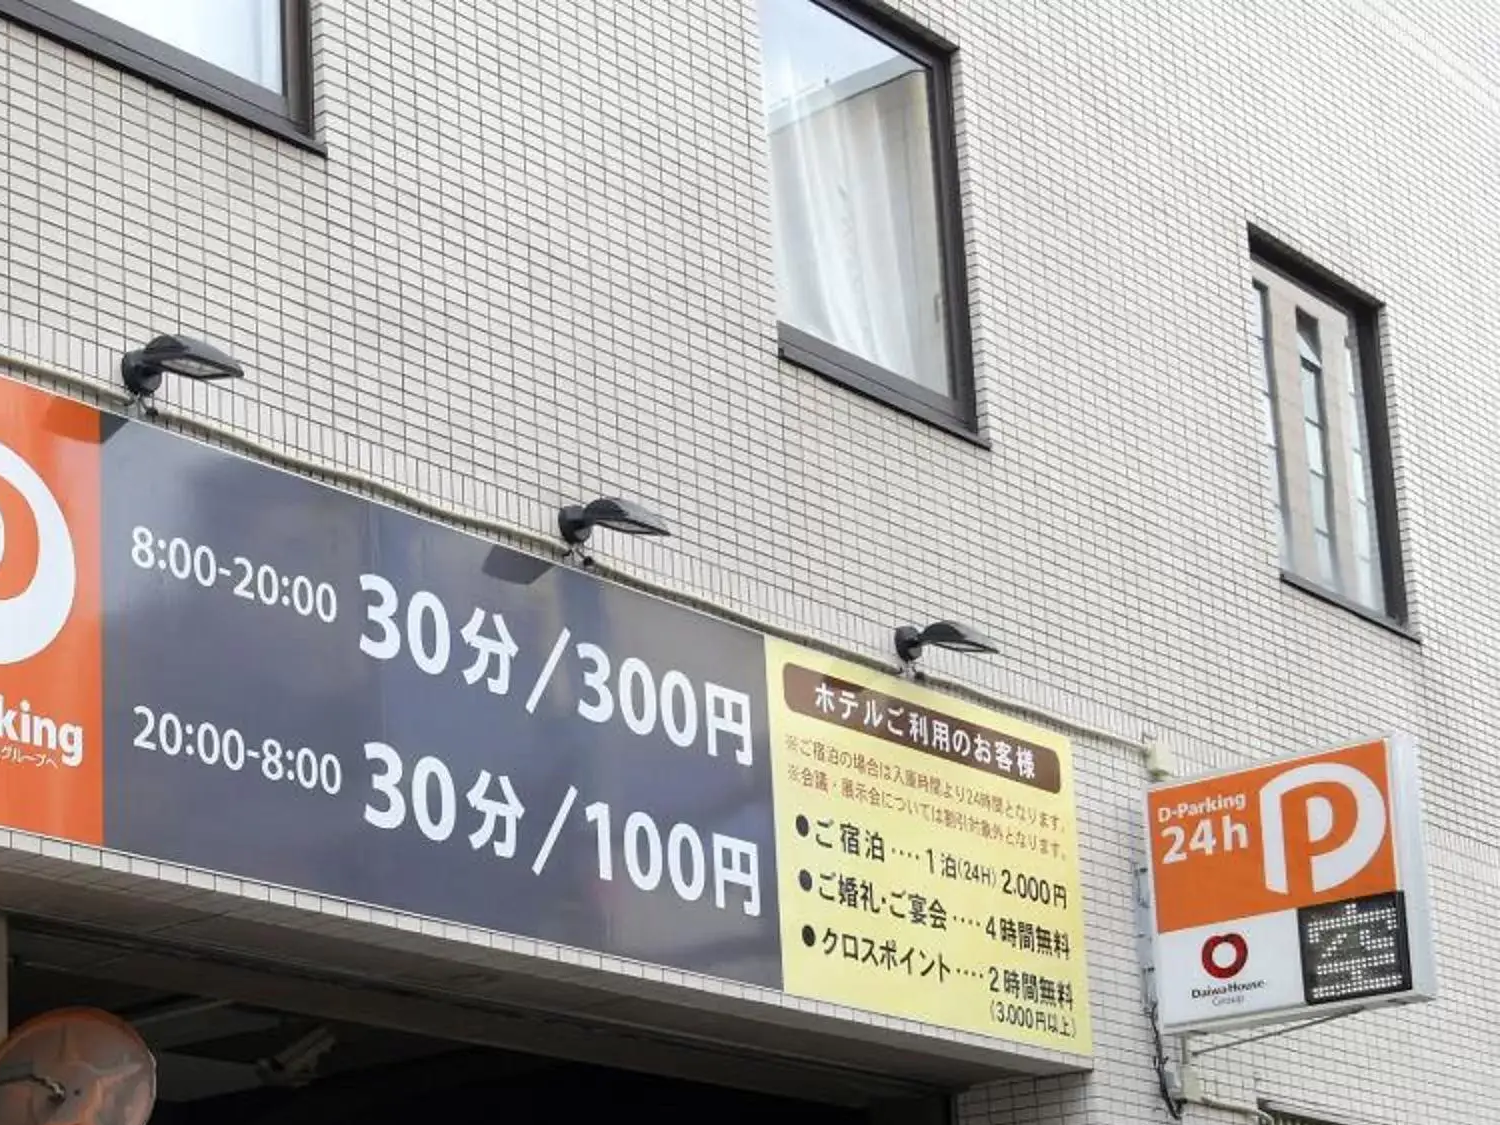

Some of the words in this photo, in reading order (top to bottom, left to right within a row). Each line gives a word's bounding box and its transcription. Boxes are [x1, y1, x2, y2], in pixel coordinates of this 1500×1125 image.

[132, 525, 338, 624] 8:00-20:00
[132, 706, 342, 798] 20:00-8:00
[815, 683, 1035, 780] ホテルご利用のお客様
[1158, 792, 1247, 823] D-Parking
[1161, 815, 1248, 865] 24h
